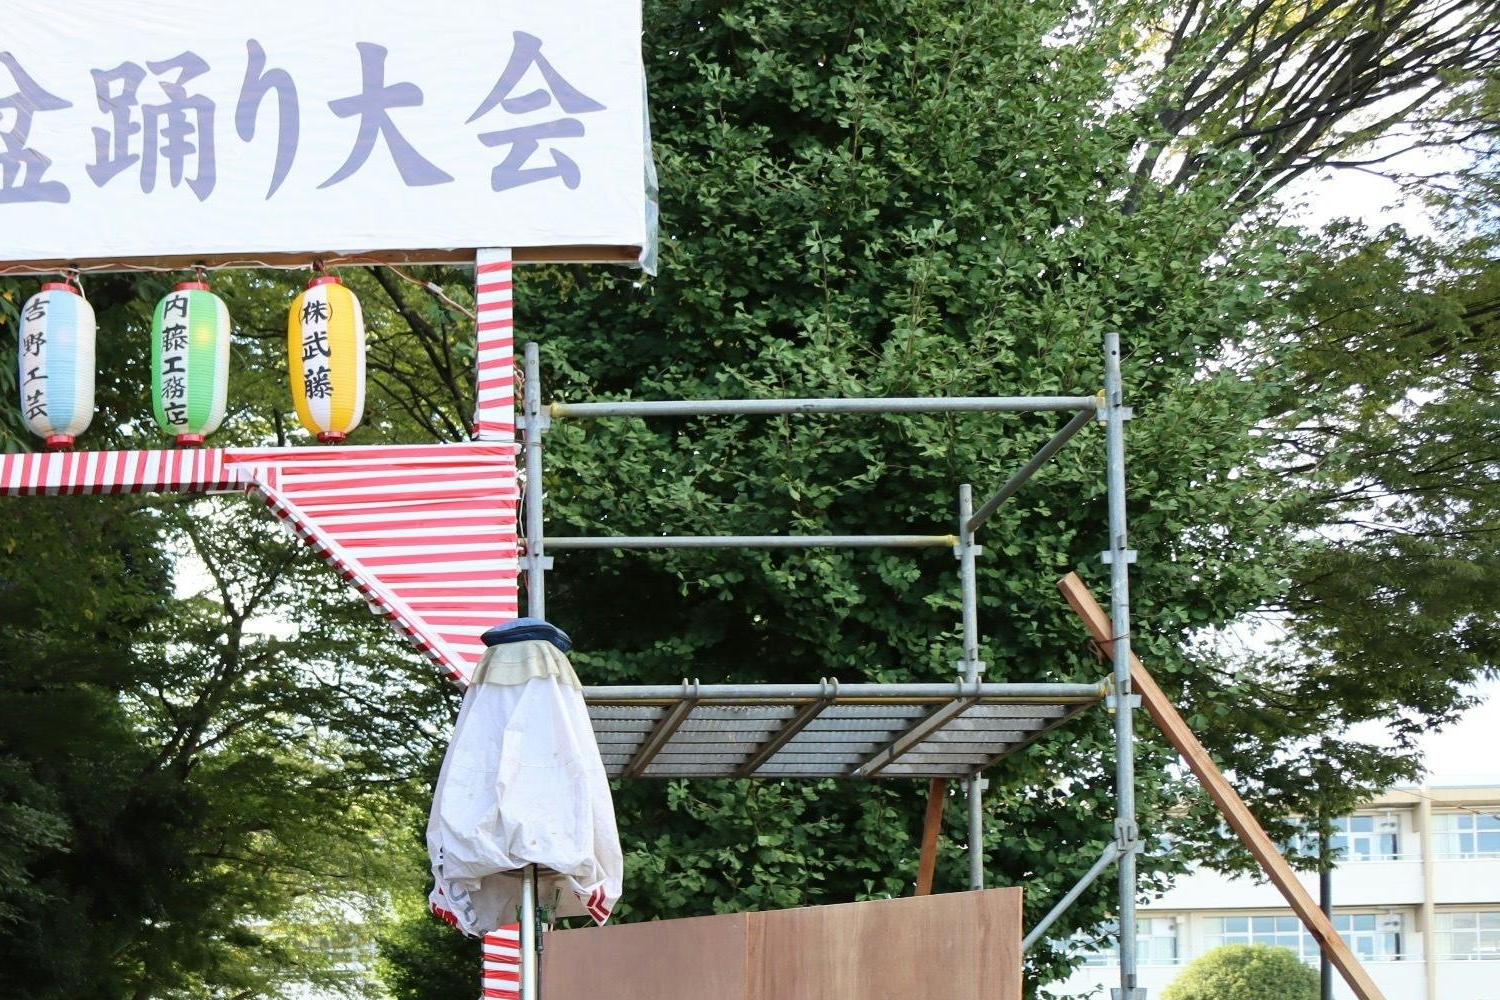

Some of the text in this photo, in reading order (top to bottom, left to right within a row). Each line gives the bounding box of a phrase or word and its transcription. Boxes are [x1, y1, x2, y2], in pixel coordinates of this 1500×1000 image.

[23, 297, 50, 420] 吉野工芸
[161, 294, 189, 425] 内藤工務店
